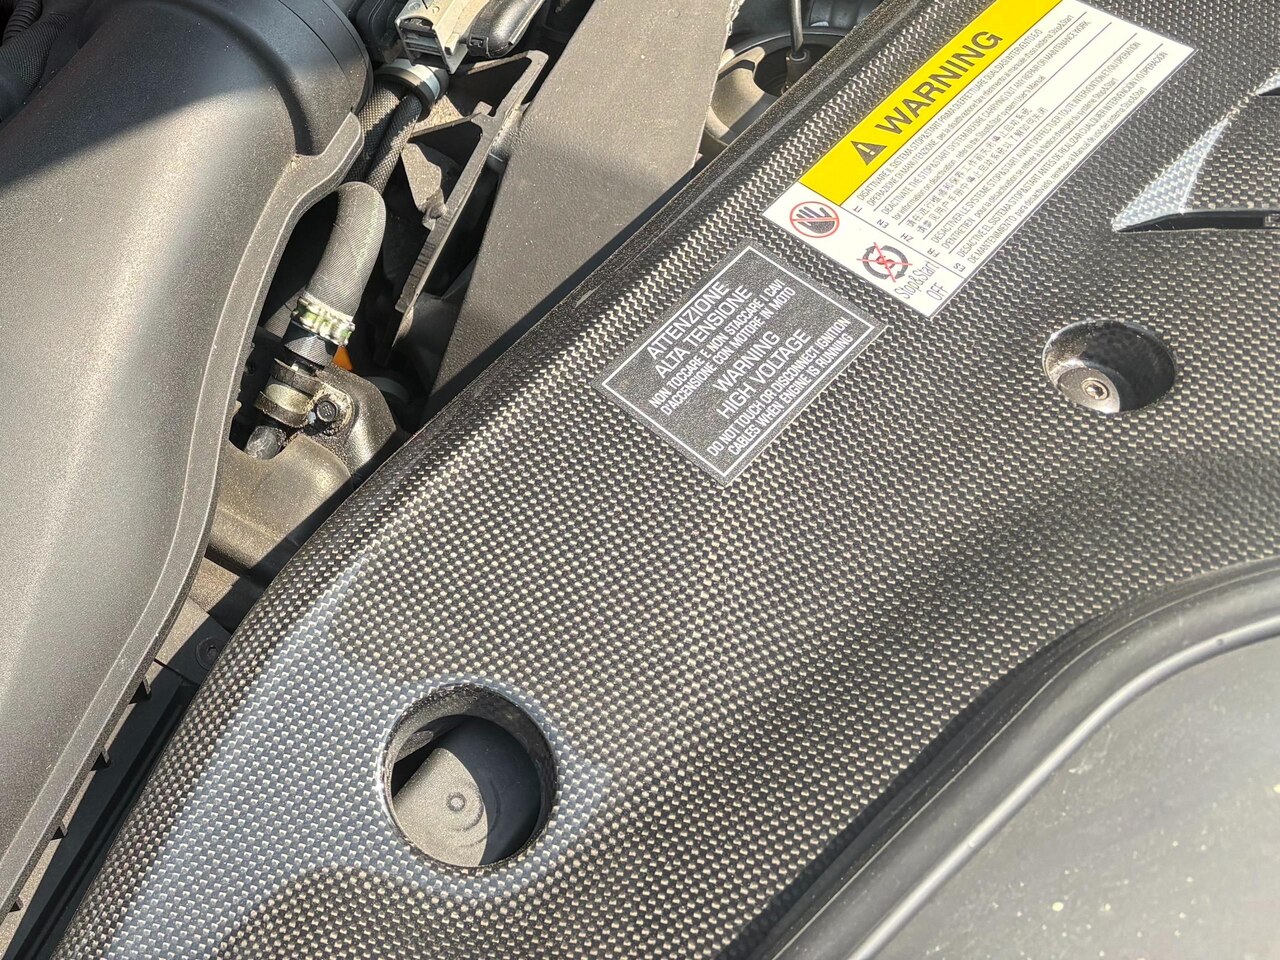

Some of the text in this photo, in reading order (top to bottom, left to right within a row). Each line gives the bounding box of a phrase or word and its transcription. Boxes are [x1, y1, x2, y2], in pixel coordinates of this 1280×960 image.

[873, 27, 1004, 139] WARNING
[854, 169, 891, 201] DISATTIVARE
[887, 146, 915, 169] SISTEMA
[879, 185, 914, 215] DEACTIVATE
[906, 176, 923, 189] THE
[915, 148, 952, 180] STOP&START
[945, 130, 971, 152] SYSTEM
[963, 115, 987, 135] BEFORE
[980, 94, 1010, 119] CARRYING
[1002, 86, 1018, 98] OUT
[929, 211, 965, 243] DESACTIVER
[954, 228, 988, 258] DESACTIVE
[986, 201, 1015, 226] SISTEMA
[1006, 172, 1043, 205] STOP&START
[642, 280, 731, 360] ATTENZIONE
[891, 258, 943, 302] Stop&Start
[923, 280, 951, 302] OFF
[646, 277, 787, 408] NON TOCCARE E NON STACCARE I CAVI
[650, 284, 754, 379] ALTA TENSIONE
[658, 285, 797, 416] D'ACCENSIONE CON MOTORE IN MOTO
[710, 328, 782, 395] WARNING
[714, 327, 813, 420] HIGH VOLTAGE
[705, 315, 852, 457] DO NOT TOUCH OR DISCONNECT IGNITION
[725, 331, 855, 456] CABLES WHEN ENGINE IS RUNNING
